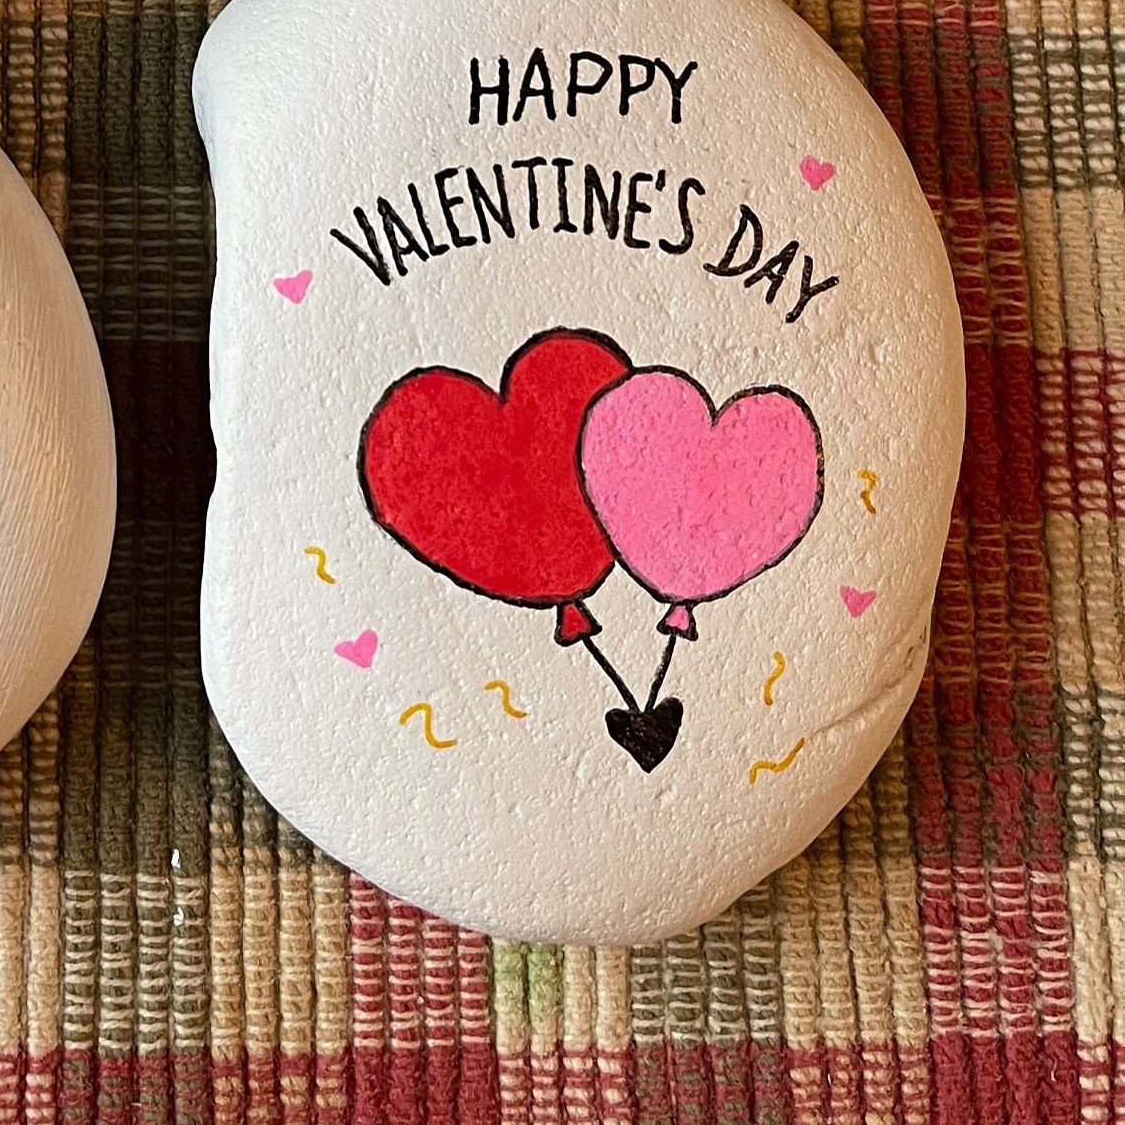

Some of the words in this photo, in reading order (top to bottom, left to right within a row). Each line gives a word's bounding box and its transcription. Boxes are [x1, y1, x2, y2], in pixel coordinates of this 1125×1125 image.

[469, 47, 699, 126] HAPPY
[330, 156, 706, 286] VALENTINE'S
[703, 204, 839, 323] DAY
